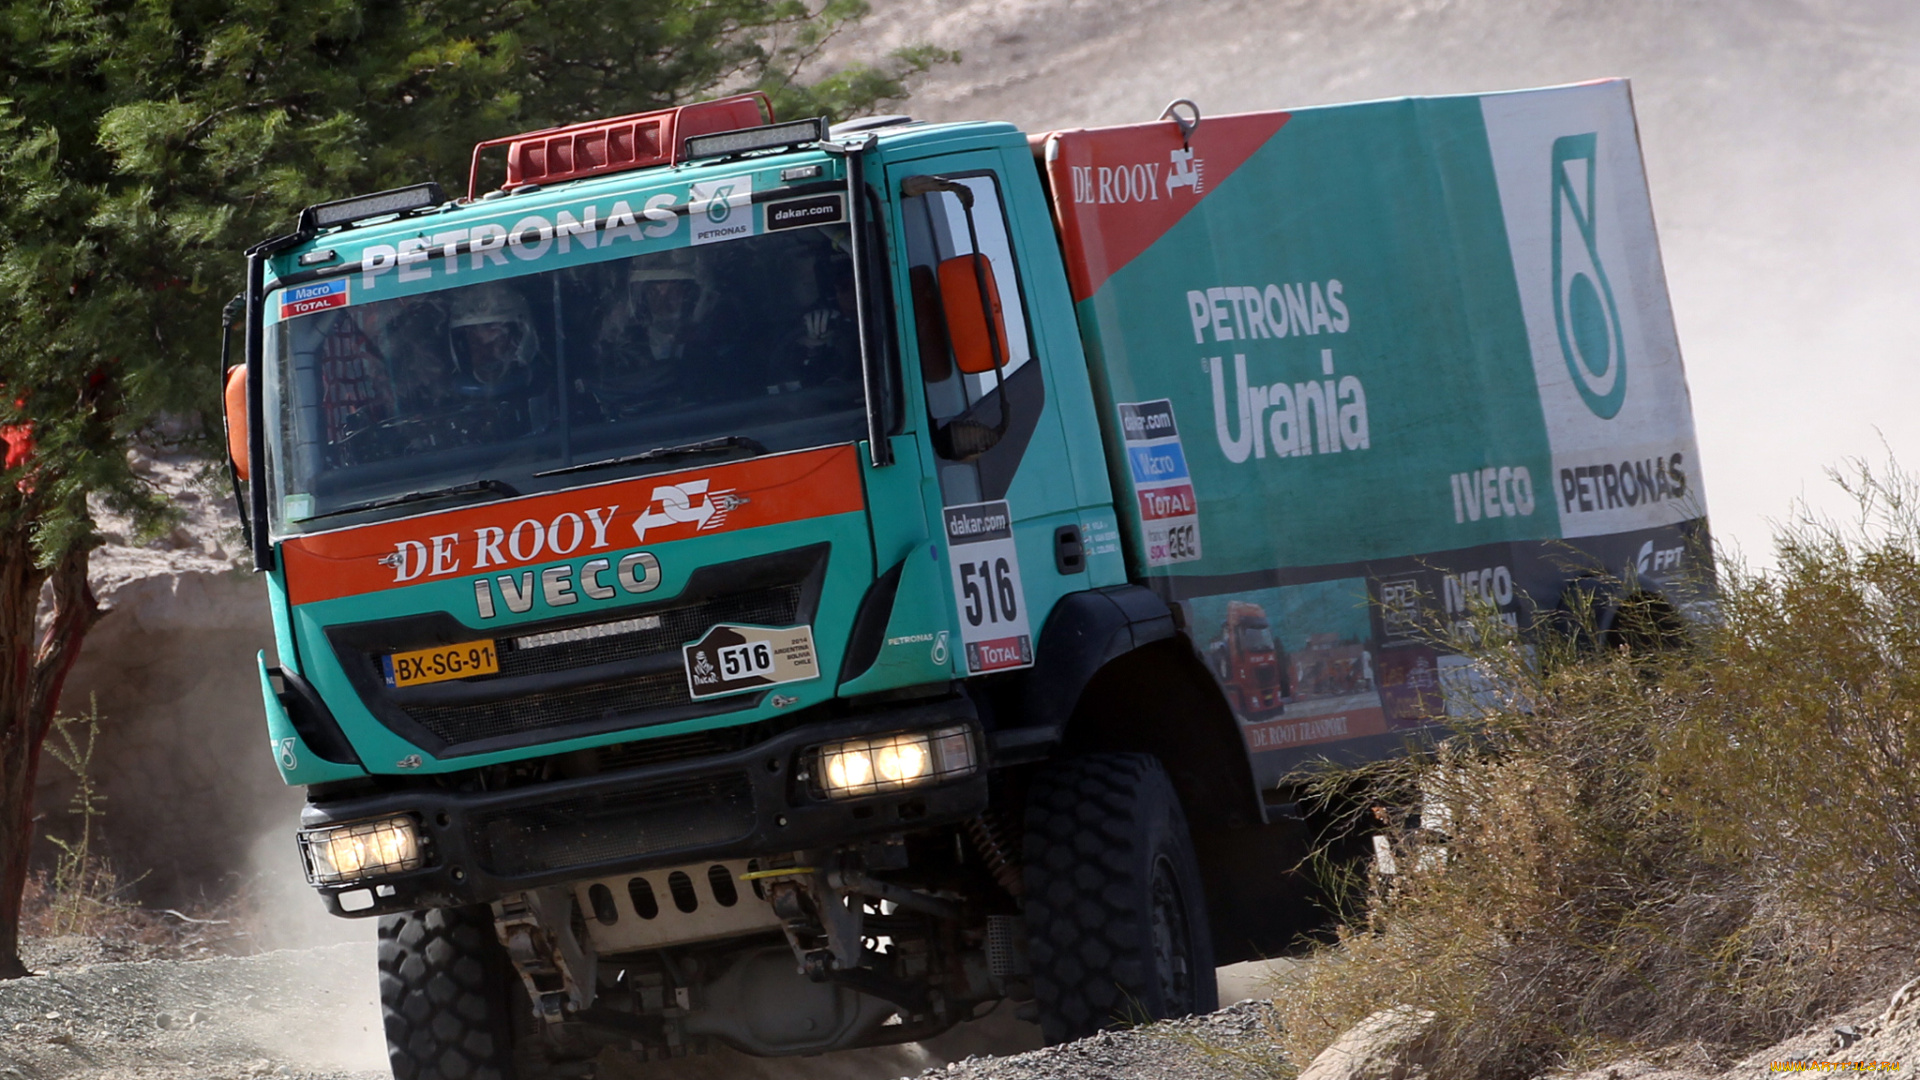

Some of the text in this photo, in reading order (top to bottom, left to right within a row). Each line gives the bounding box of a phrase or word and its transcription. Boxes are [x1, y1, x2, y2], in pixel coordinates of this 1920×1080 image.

[1071, 163, 1160, 204] DE ROOY
[775, 204, 833, 221] dakar.com
[362, 194, 679, 290] PETRONAS
[698, 225, 746, 240] PETRONAS
[294, 300, 331, 312] TOTAL
[295, 286, 330, 300] Macro
[1187, 278, 1350, 344] PETRONAS
[1209, 349, 1370, 464] Urania
[1451, 465, 1535, 524] IVECO
[1560, 452, 1686, 514] PETRONAS
[1144, 492, 1190, 516] TOTAL
[950, 514, 1006, 536] dakar.com
[392, 505, 620, 583] DE ROOY
[1654, 546, 1685, 571] FPT
[474, 551, 662, 619] IVECO
[959, 557, 1017, 627] 516
[1443, 566, 1513, 613] IVECO
[774, 644, 809, 655] ARGENTINA
[791, 637, 808, 645] 2014
[888, 633, 933, 645] PETRONAS
[398, 647, 491, 681] BX-SG-91
[723, 644, 770, 675] 516
[787, 651, 811, 660] BOLIVIA
[794, 658, 812, 666] CHILE
[980, 646, 1019, 664] TOTAL
[1252, 717, 1348, 747] DE ROOY TRANSPORT
